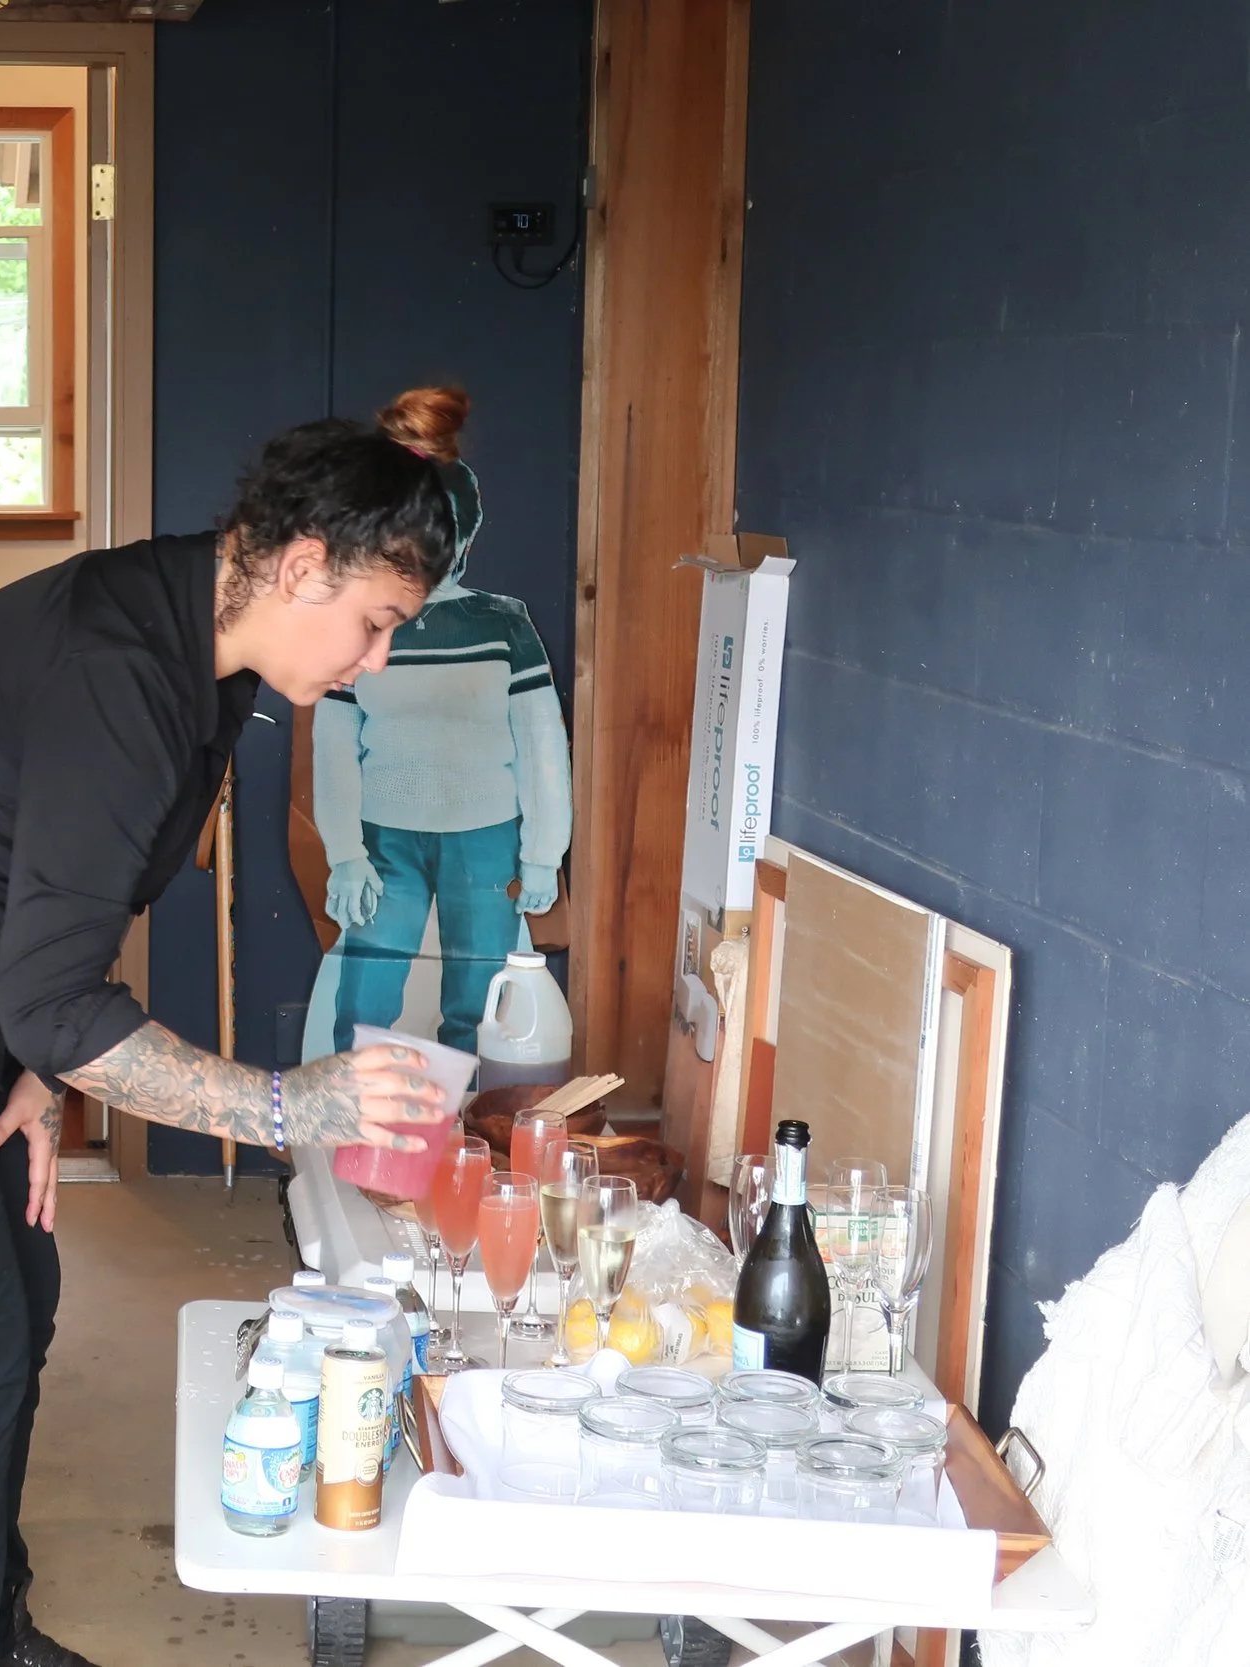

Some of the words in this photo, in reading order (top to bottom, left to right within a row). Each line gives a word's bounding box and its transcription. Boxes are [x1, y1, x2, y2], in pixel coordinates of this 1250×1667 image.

[752, 719, 761, 744] 100%
[758, 658, 765, 672] 0%
[710, 674, 731, 833] lifeproof
[739, 763, 762, 844] lifeproof
